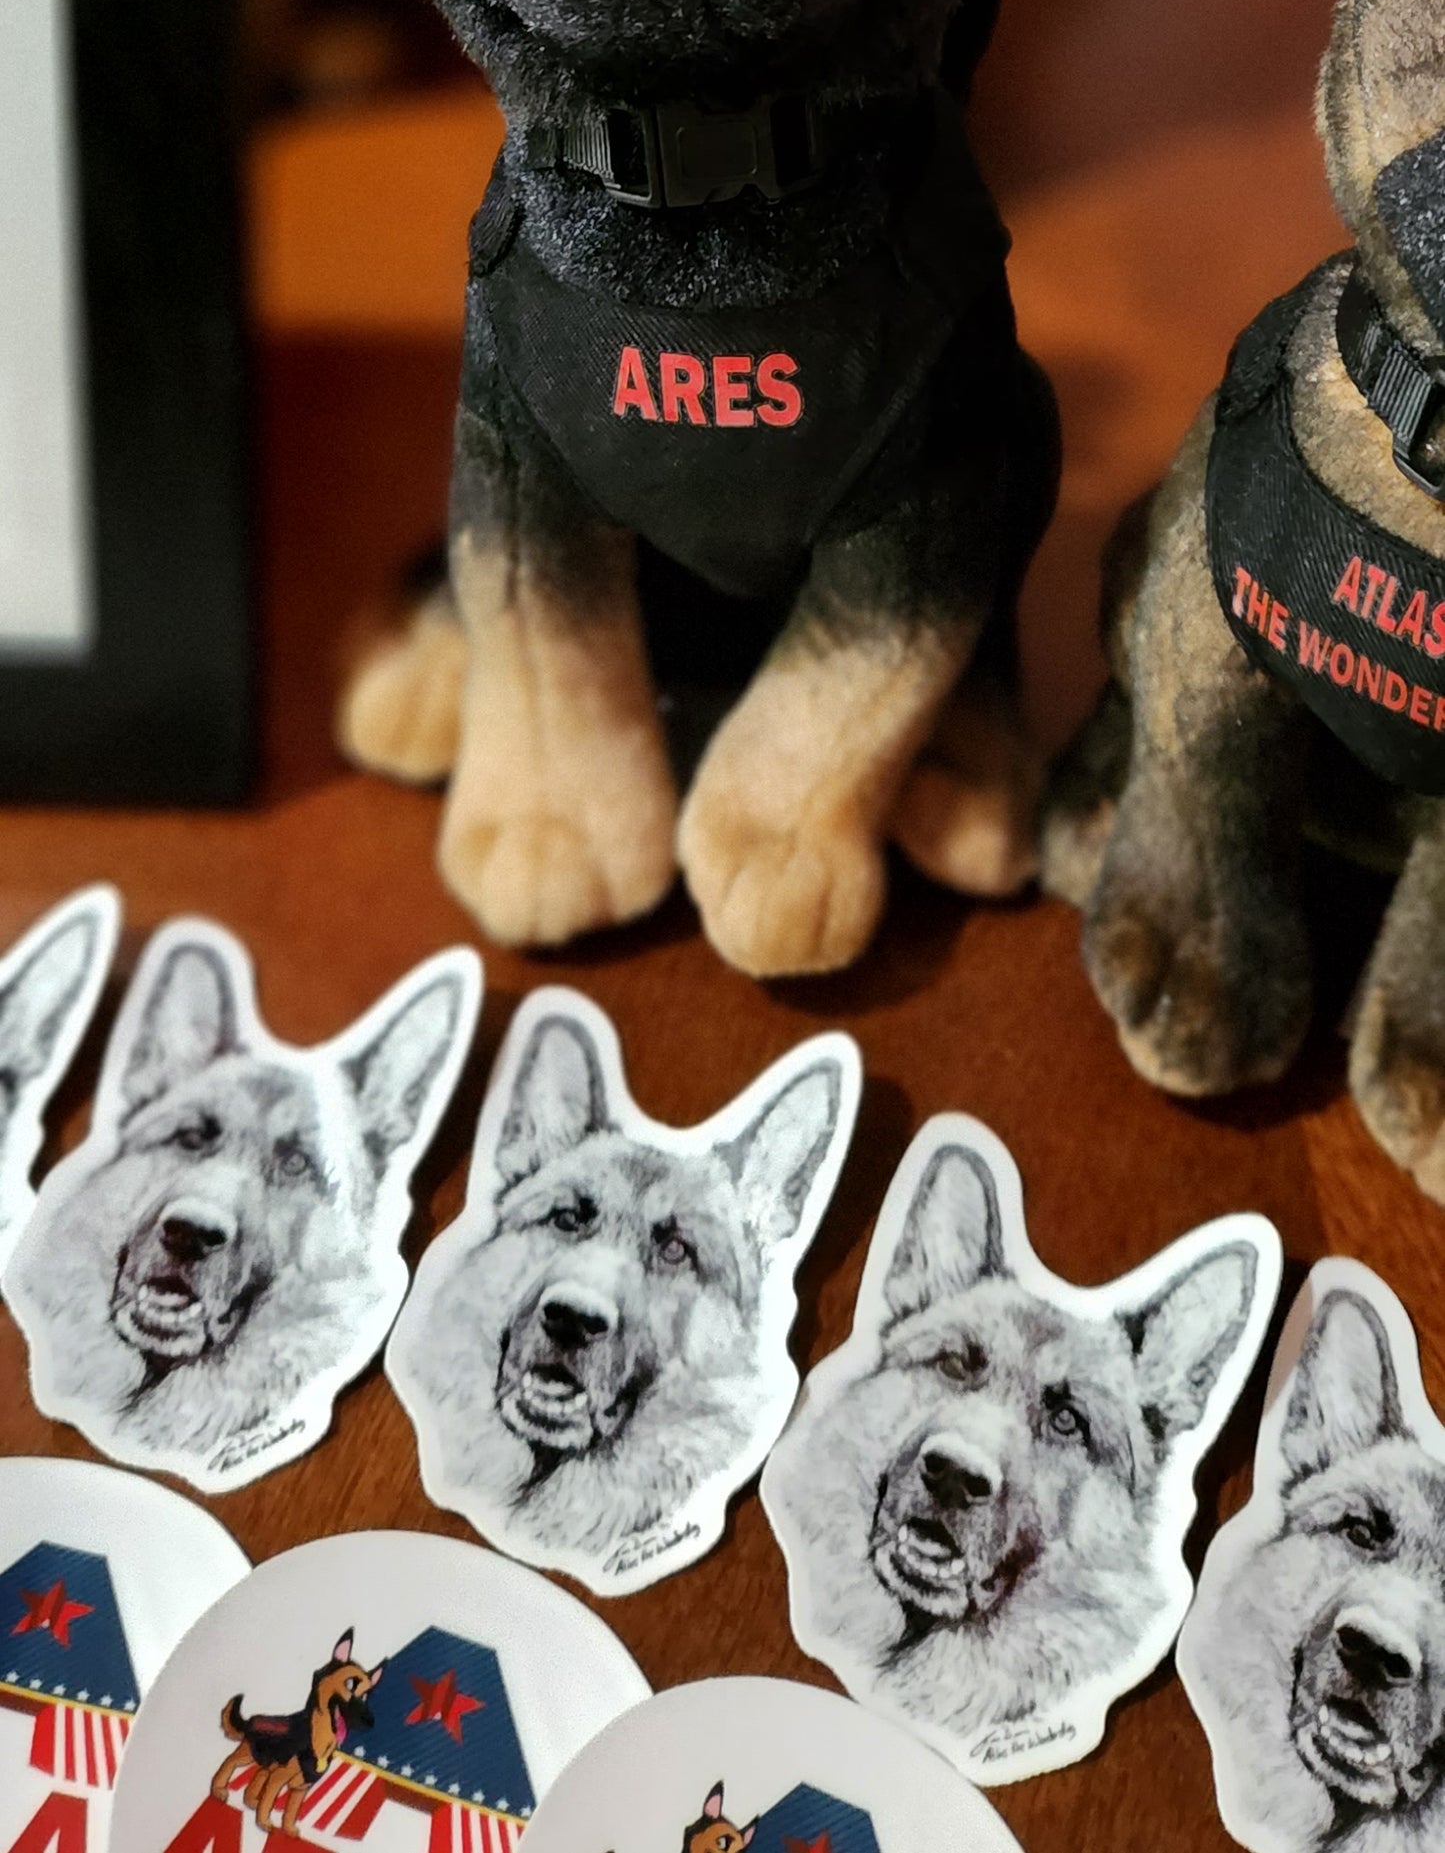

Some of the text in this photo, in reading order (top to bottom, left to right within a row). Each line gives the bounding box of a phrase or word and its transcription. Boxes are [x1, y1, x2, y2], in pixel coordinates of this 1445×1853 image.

[613, 345, 802, 427] ARES
[1232, 566, 1289, 650] THE
[1333, 556, 1445, 657] ATLAS
